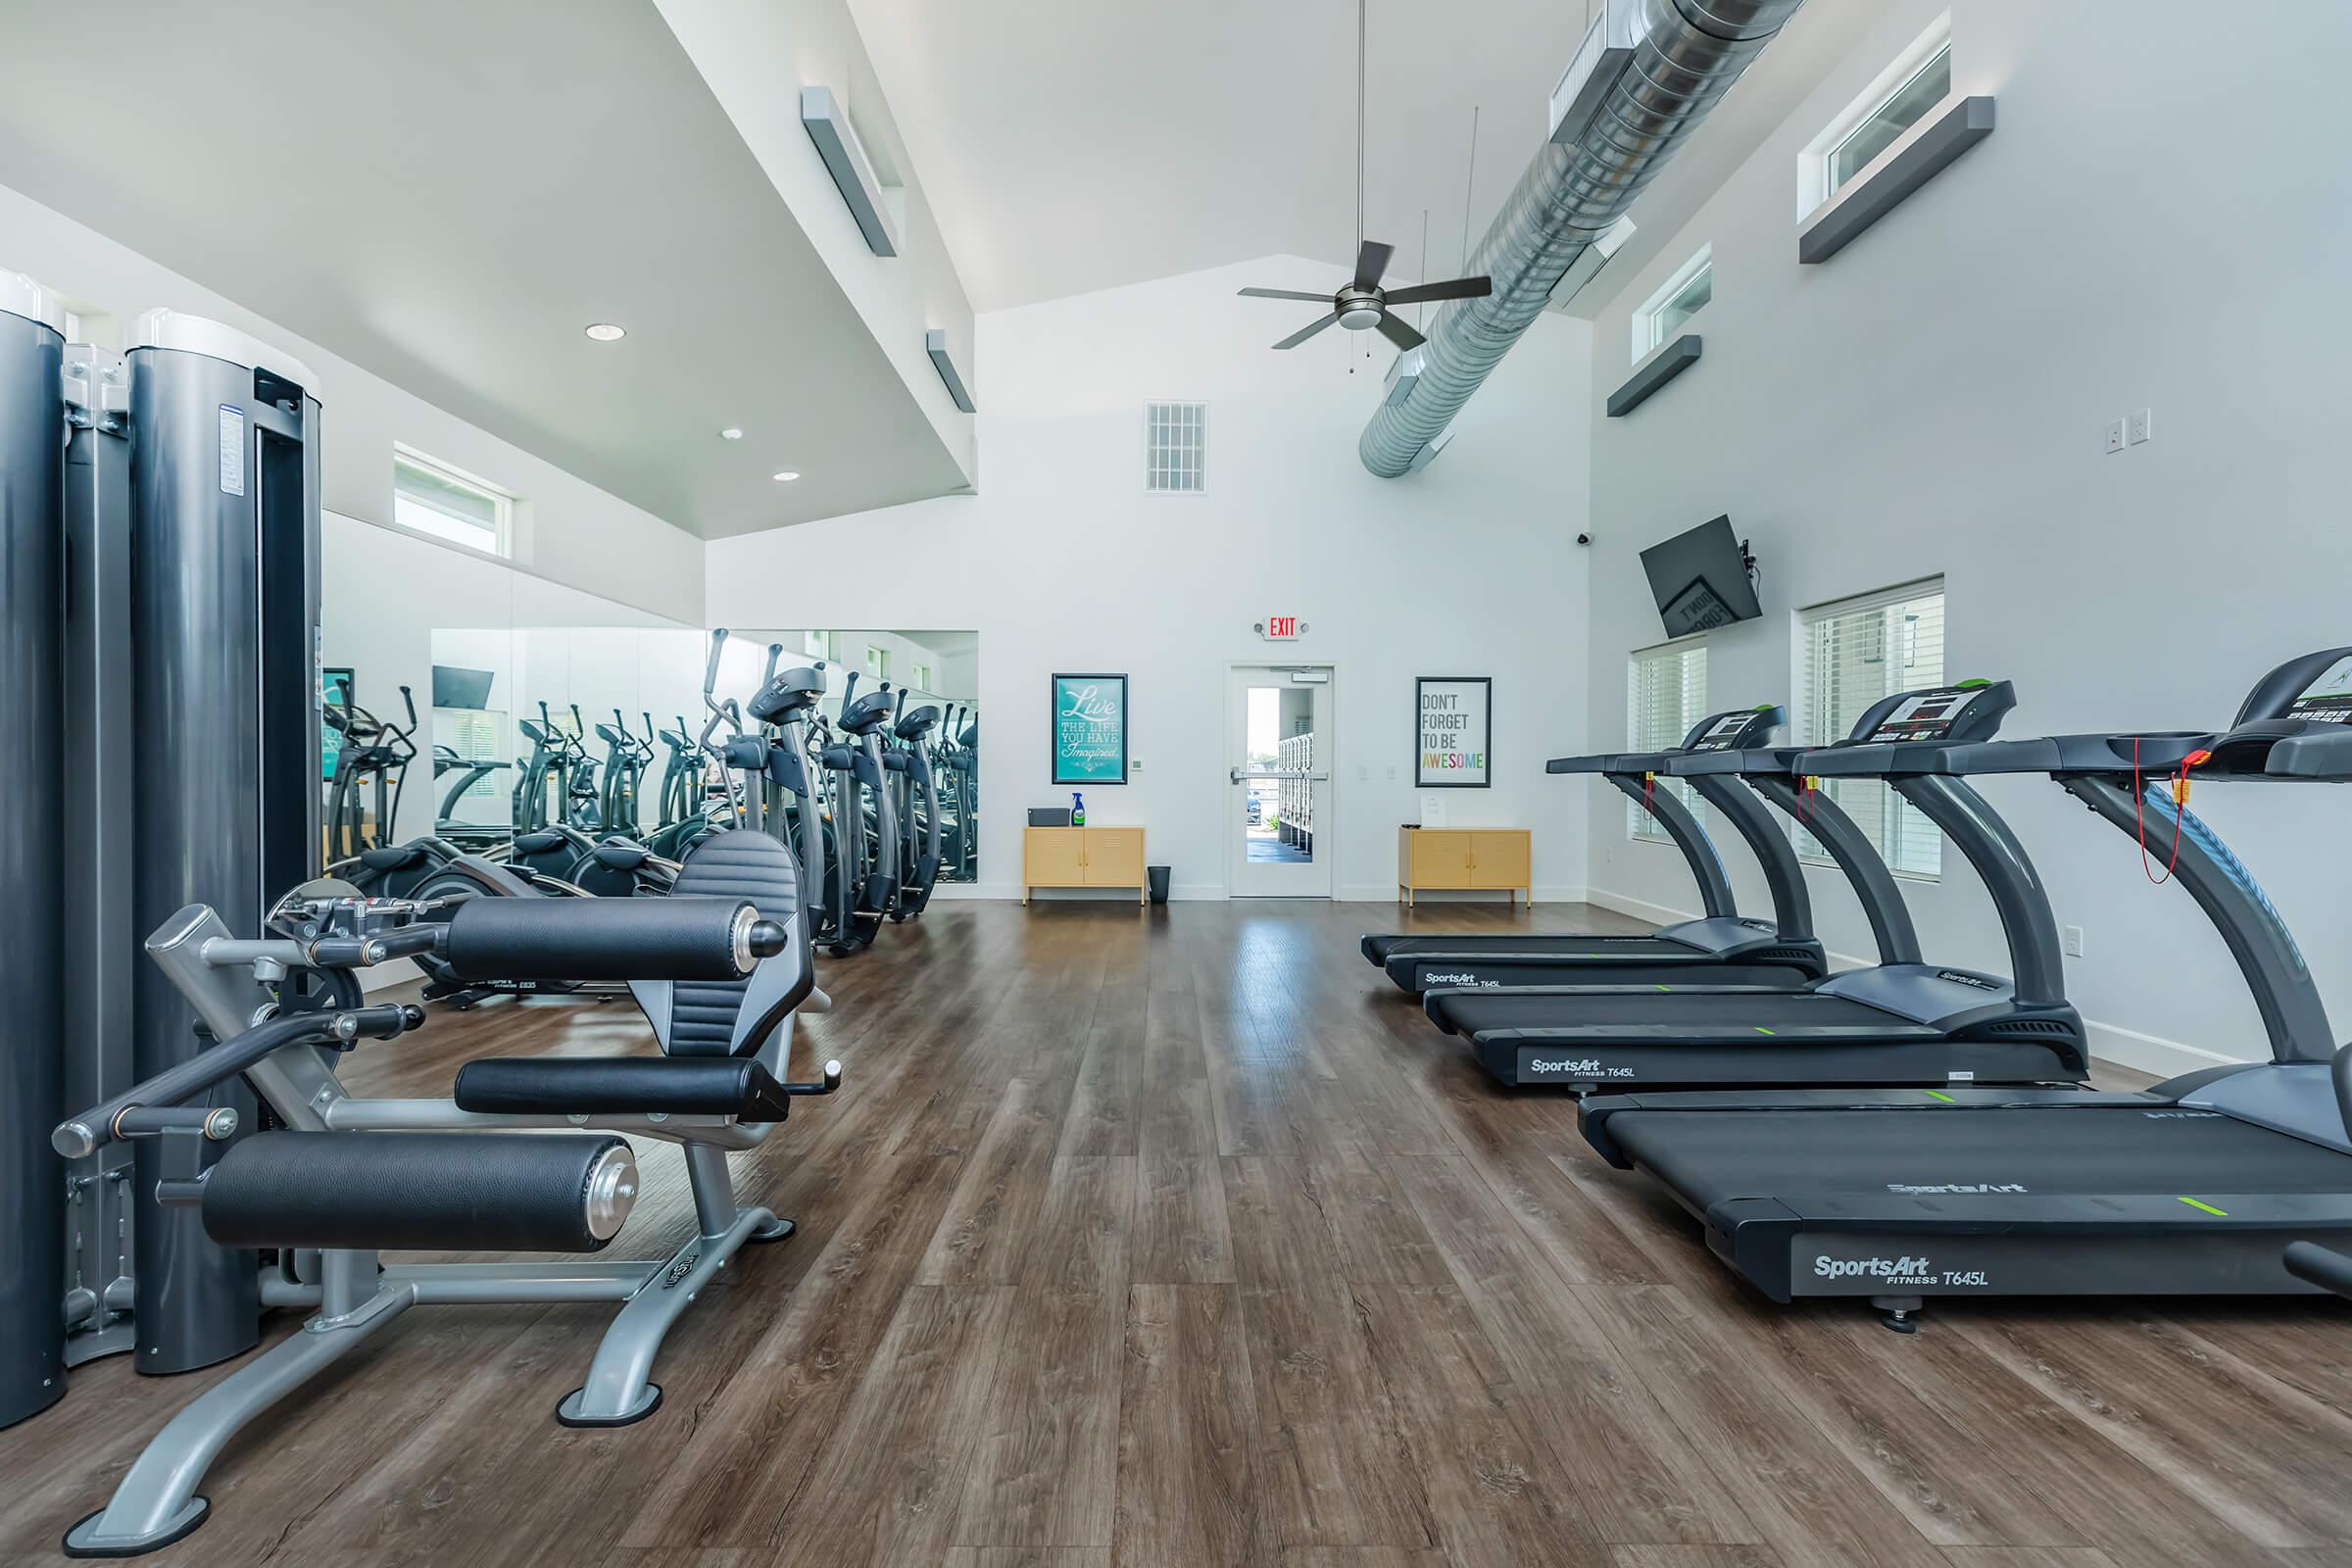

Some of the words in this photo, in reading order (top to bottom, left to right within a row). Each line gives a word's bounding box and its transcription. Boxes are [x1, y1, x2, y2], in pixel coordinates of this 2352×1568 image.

[1270, 616, 1296, 636] EXIT
[1061, 684, 1117, 721] Live
[1422, 694, 1458, 710] DON'T
[1061, 722, 1086, 732] THE
[1090, 722, 1118, 732] LIFE
[1422, 713, 1469, 730] FORGET
[1061, 732, 1083, 743] YOU
[1087, 732, 1118, 743] HAVE
[1422, 733, 1438, 749] TO
[1441, 733, 1457, 749] BE
[1422, 753, 1484, 769] AWESOME
[1426, 972, 1475, 984] SportsArt
[1531, 1058, 1600, 1073] SportsArt
[1607, 1068, 1635, 1077] T645L
[1886, 1184, 2029, 1196] SportsArt
[1814, 1255, 1930, 1280] SportsArt
[1886, 1276, 1937, 1285] FITNESS
[1943, 1272, 1988, 1286] T645L
